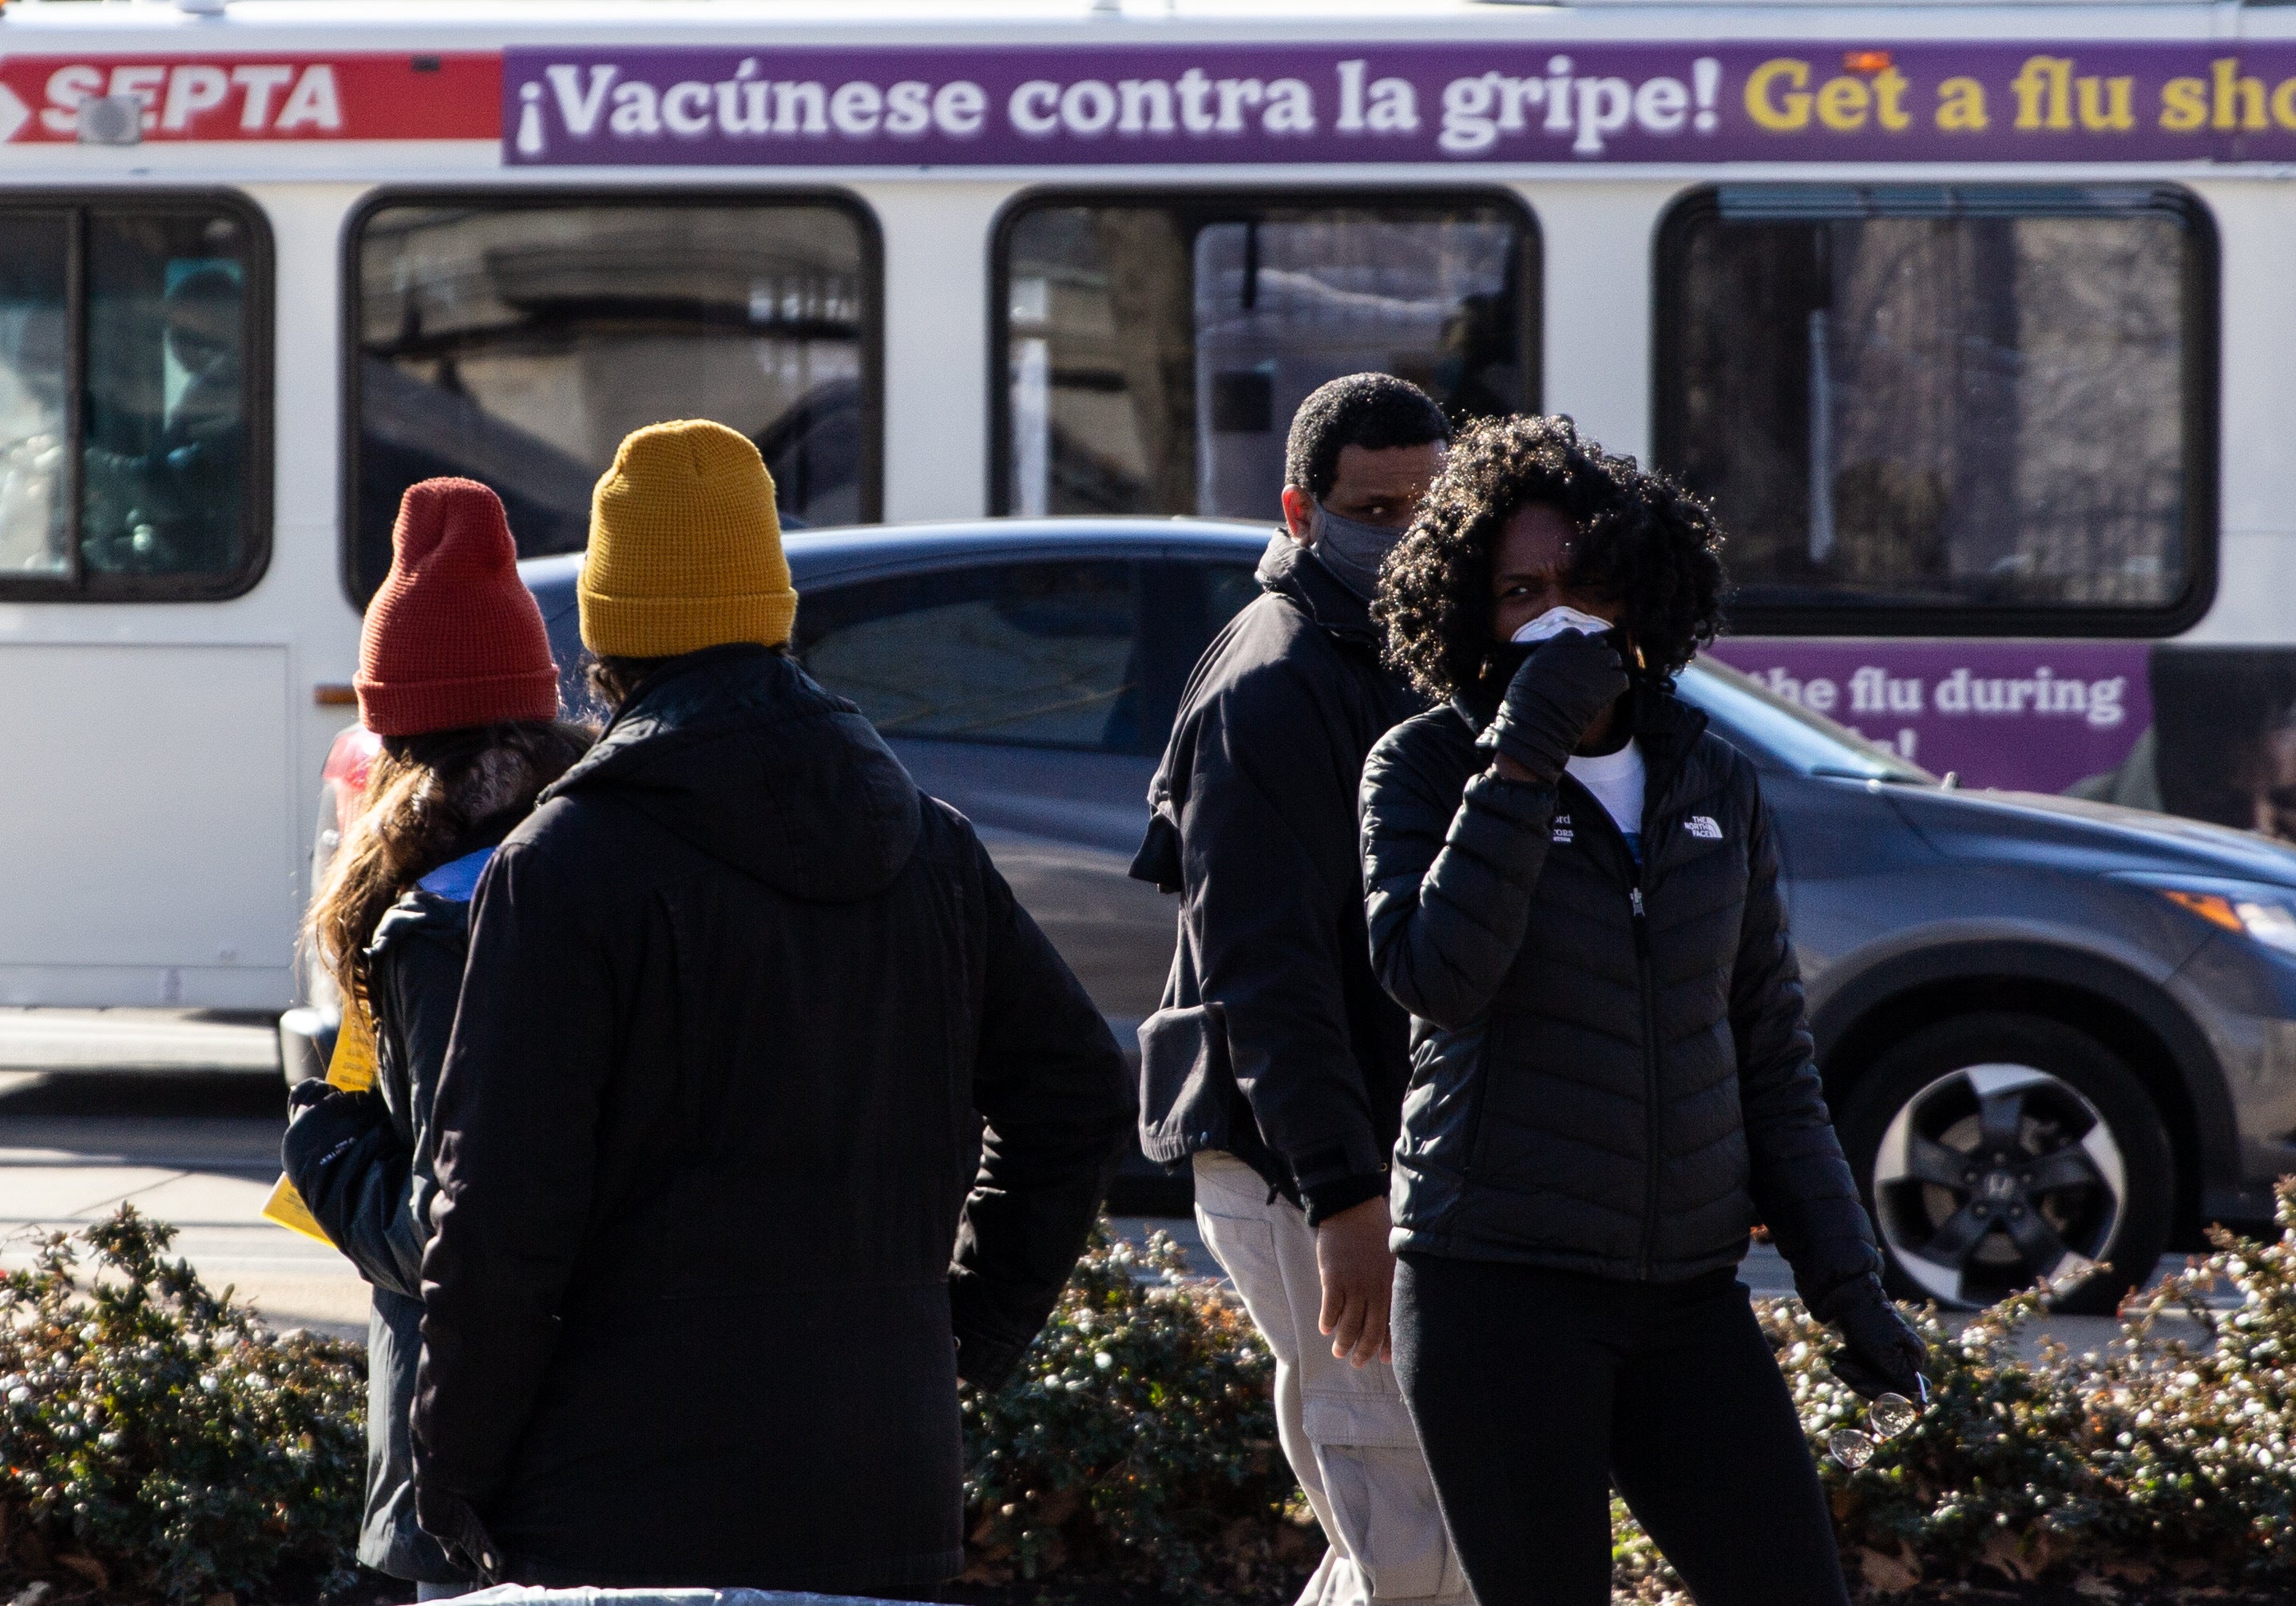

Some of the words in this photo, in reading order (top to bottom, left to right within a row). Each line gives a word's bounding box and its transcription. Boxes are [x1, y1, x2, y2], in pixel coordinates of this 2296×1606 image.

[39, 65, 342, 133] SEPTA
[517, 57, 987, 155] ¡Vacúnese
[1008, 68, 1316, 133] contra
[1335, 59, 1420, 132] la
[1439, 54, 1721, 152] gripe!
[1744, 57, 1911, 132] Get
[1935, 76, 1989, 131] a
[2013, 56, 2136, 131] flu
[1848, 665, 1923, 712] flu
[1934, 666, 2124, 728] during
[1684, 822, 1708, 831] NORTH
